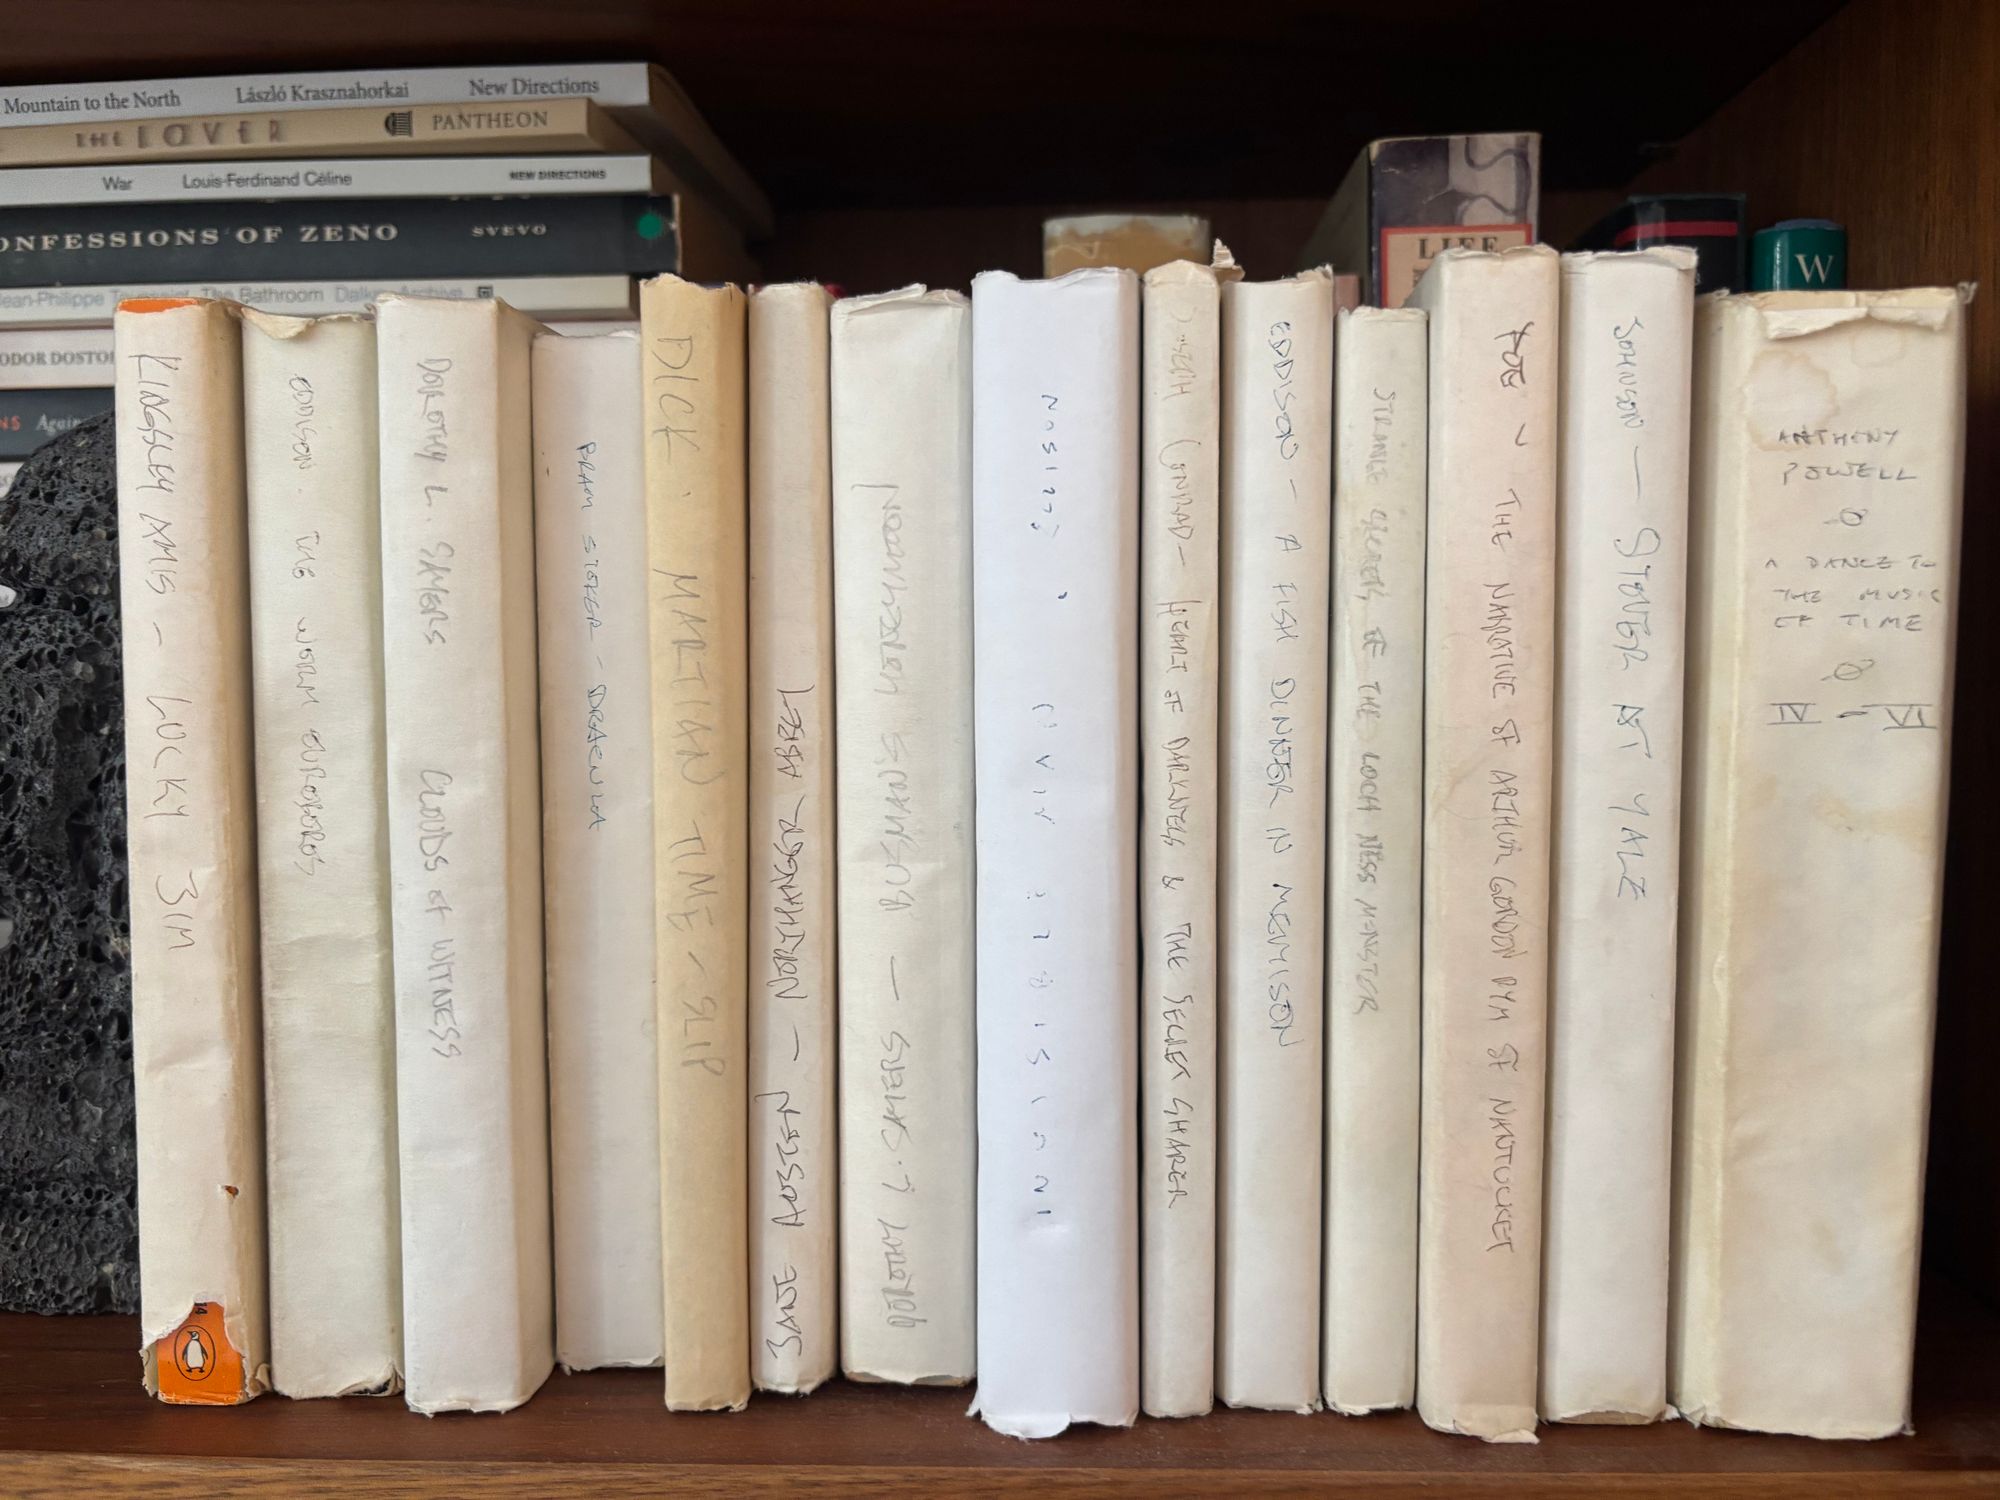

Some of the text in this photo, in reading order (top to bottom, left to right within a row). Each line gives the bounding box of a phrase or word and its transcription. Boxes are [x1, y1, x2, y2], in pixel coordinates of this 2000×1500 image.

[3, 89, 182, 115] Mountain to the North
[236, 80, 410, 104] László Krasznahorkai
[432, 110, 549, 132] PANTHEON
[468, 76, 600, 97] New Directions
[102, 168, 353, 191] War Louis-Ferdinand Céline
[509, 168, 608, 181] NEW DIRECTIONS
[235, 225, 283, 245] OF
[300, 223, 399, 243] ZENO
[471, 223, 547, 238] SVEVO
[1795, 253, 1834, 283] W
[239, 286, 324, 303] Bathroom
[1161, 306, 1198, 402] JOSEPH
[1269, 321, 1301, 461] EDDISON
[1494, 321, 1535, 390] POE
[1613, 316, 1645, 430] JOHNSON
[129, 354, 182, 493] KINGSLEY
[288, 374, 317, 471] EDDISON
[414, 356, 453, 464] DOROTHY
[650, 334, 702, 466] DICK
[1778, 424, 1901, 447] ANTHONY
[576, 441, 598, 511] BRAM
[1159, 439, 1201, 541] CONRAD
[1781, 462, 1918, 485] POWELL
[139, 513, 177, 595] AMIS
[1274, 533, 1303, 552] A
[1490, 487, 1522, 552] THE
[1764, 554, 1937, 570] A DANCE TO
[419, 541, 455, 646] SAYERS
[581, 533, 604, 643] STOKER
[850, 483, 908, 696] HONEYMOON
[1270, 582, 1299, 643] FISH
[1614, 527, 1661, 672] STOVER
[1772, 587, 1942, 604] THE MUSIC
[1773, 613, 1925, 632] OF TIME
[293, 616, 324, 706] WORM
[651, 566, 727, 787] MARTIAN
[1156, 600, 1203, 673] HEART
[1480, 581, 1519, 700] NARRATIVE
[774, 683, 816, 781] ABBEY
[1164, 690, 1185, 714] OF
[1265, 677, 1297, 809] DINNER
[1353, 387, 1396, 1016] STRANGE SECRETS OF THE LOCH NESS MONSTER
[1490, 718, 1521, 747] OF
[1612, 703, 1652, 759] AT
[1767, 702, 1822, 725] IV
[144, 695, 192, 820] LUCKY
[584, 683, 609, 831] DRACULA
[1160, 736, 1191, 847] DARKNESS
[418, 768, 455, 873] CLOUDS
[1265, 826, 1294, 855] IN
[1488, 769, 1522, 867] ARTHUR
[1609, 792, 1651, 901] YALE
[766, 794, 810, 1000] NORTHANGER
[1160, 875, 1185, 891] &
[1488, 875, 1528, 960] GORDON
[1162, 922, 1193, 971] THE
[427, 935, 463, 1060] WITNESS
[1162, 995, 1194, 1081] SECRET
[1488, 975, 1519, 1022] PYM
[880, 1030, 913, 1152] SAYERS
[1486, 1043, 1520, 1074] OF
[753, 1090, 807, 1227] AUSTEN
[1164, 1097, 1194, 1210] SHARER
[1486, 1097, 1518, 1253] NANTUCKET
[877, 1217, 928, 1329] DOROTHY
